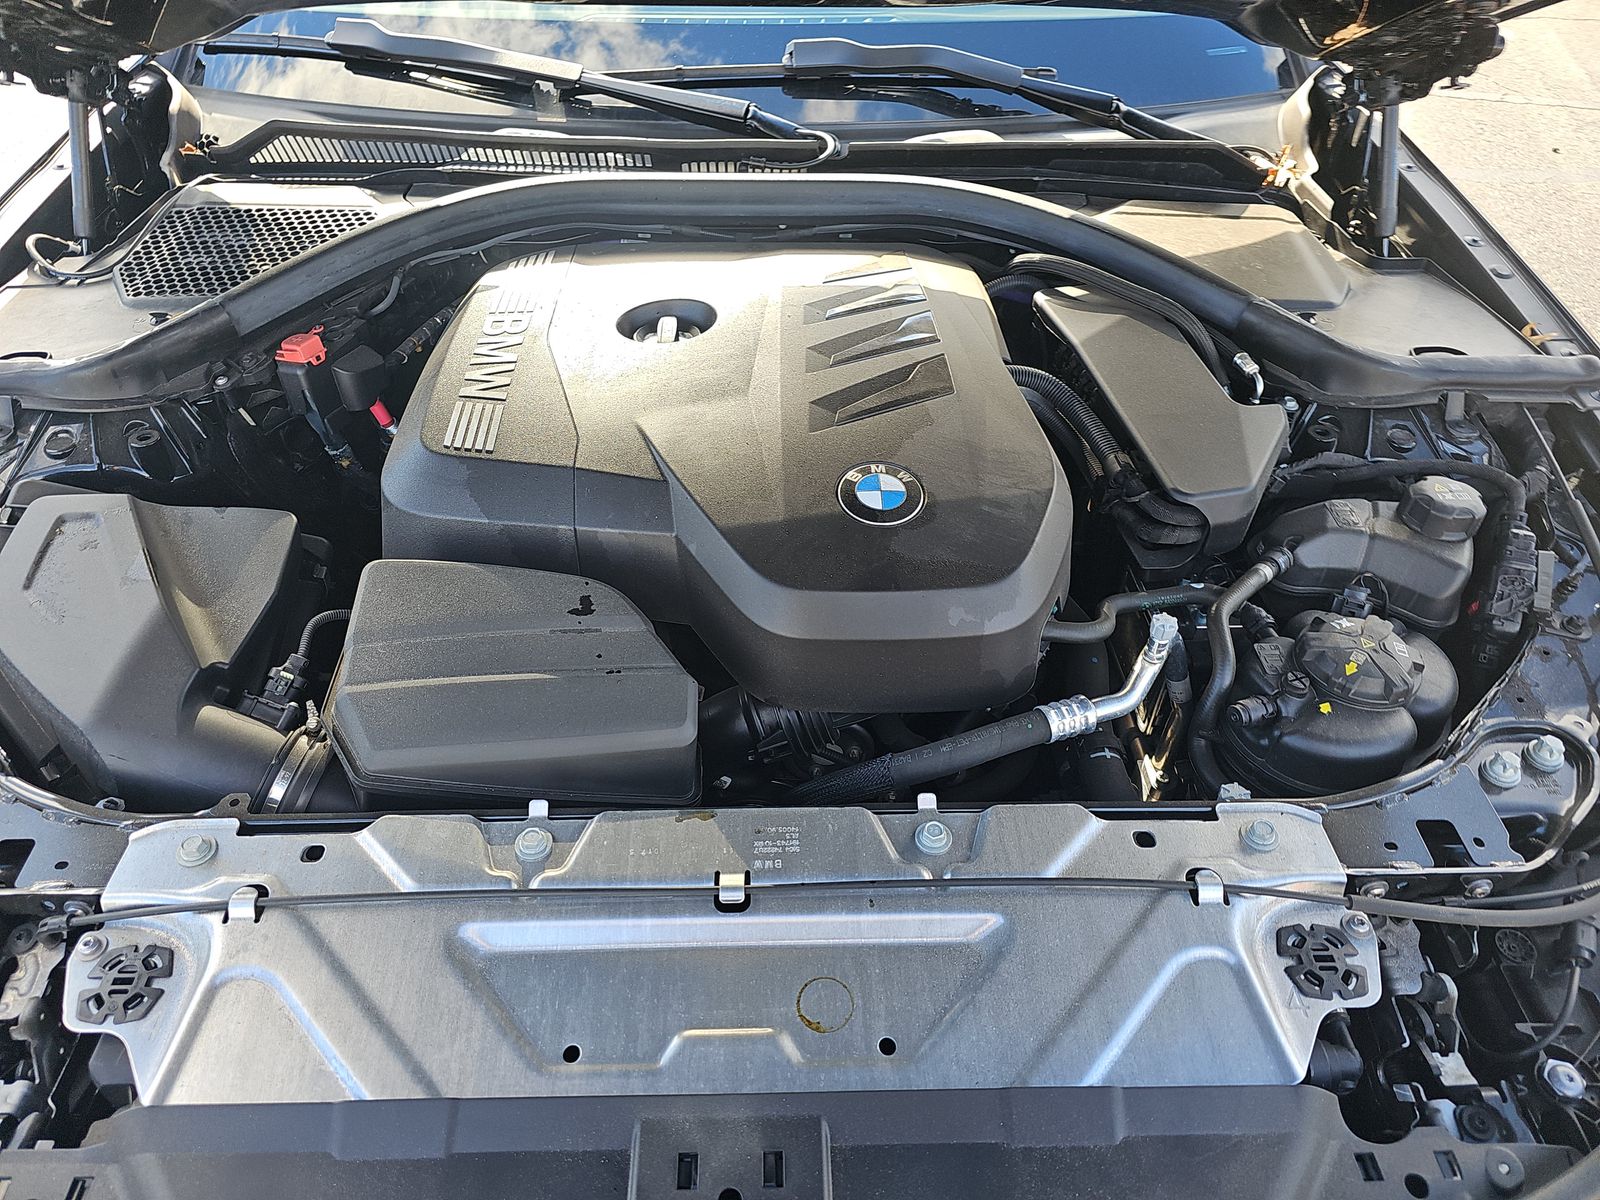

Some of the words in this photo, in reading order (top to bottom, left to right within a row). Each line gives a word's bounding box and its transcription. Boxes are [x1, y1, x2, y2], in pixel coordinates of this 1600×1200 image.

[458, 313, 533, 402] BMW
[846, 464, 914, 483] BMW
[753, 859, 782, 869] BMW
